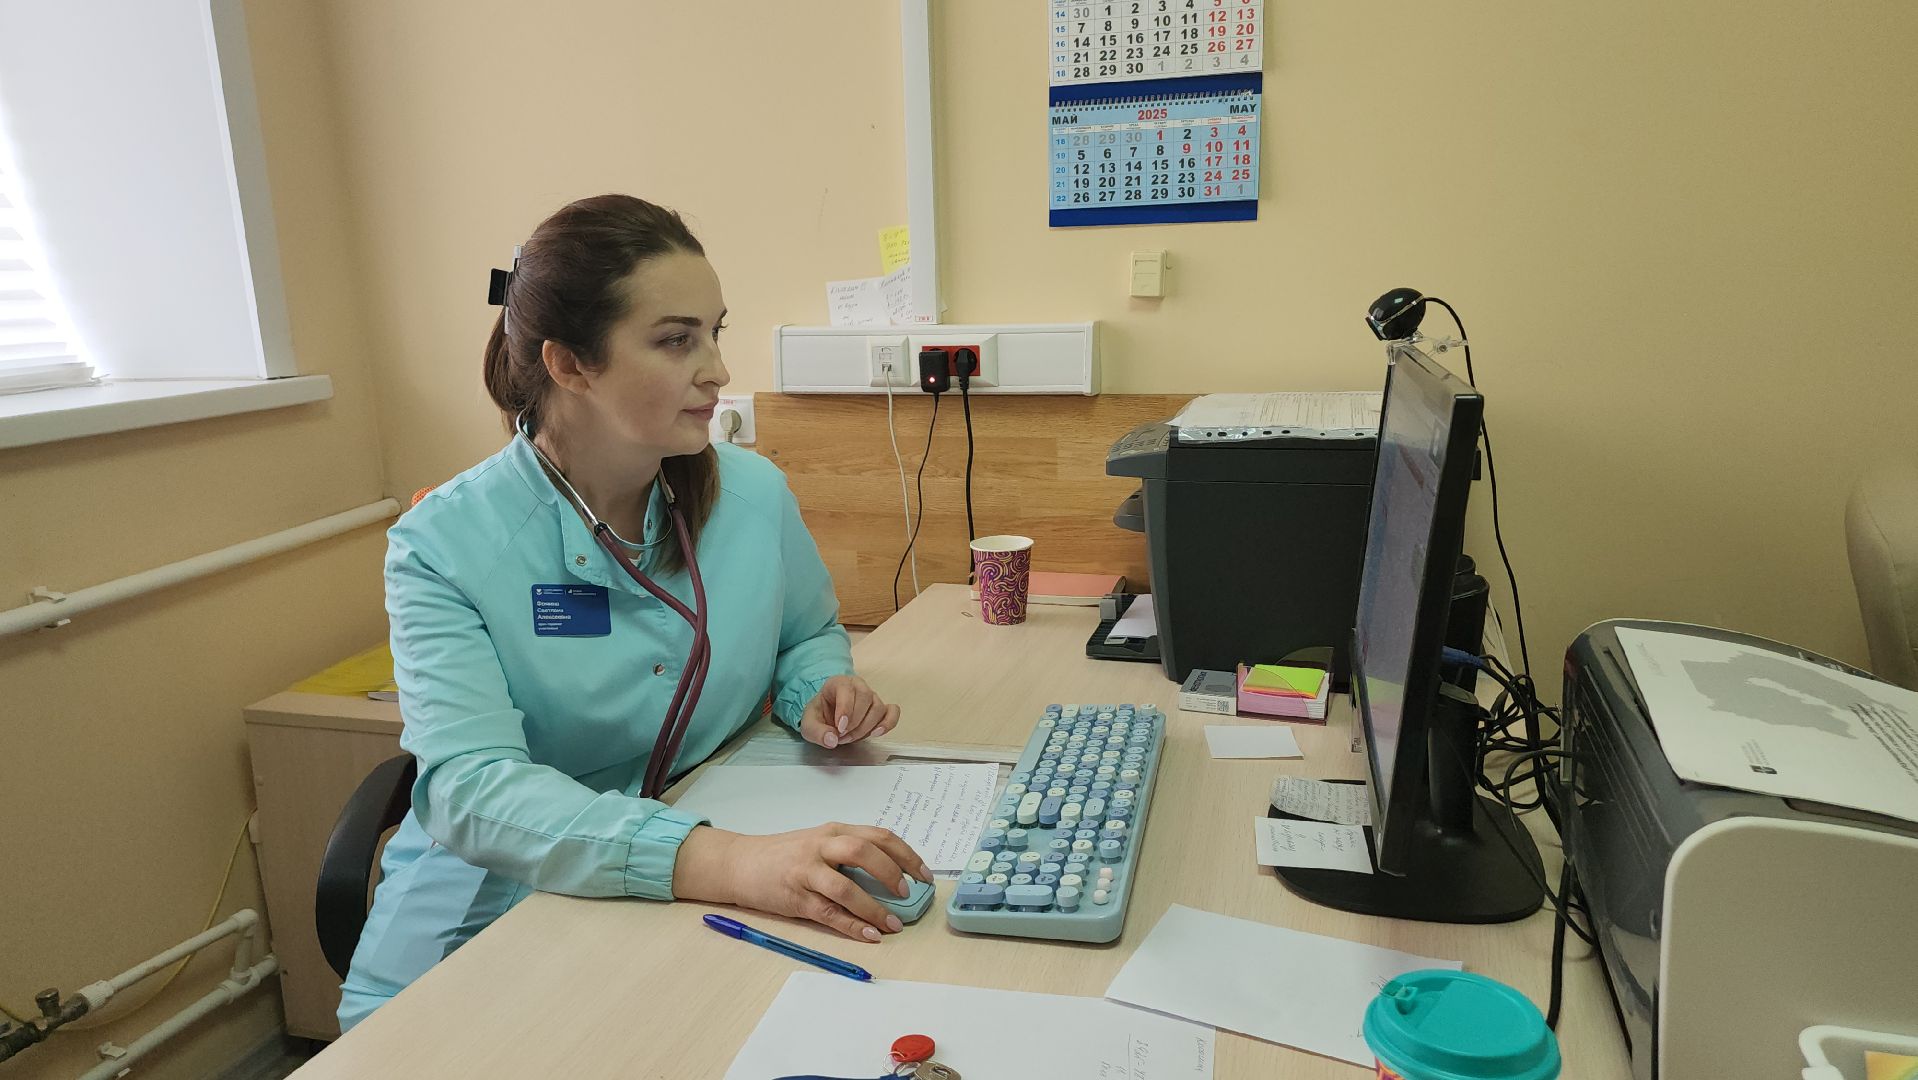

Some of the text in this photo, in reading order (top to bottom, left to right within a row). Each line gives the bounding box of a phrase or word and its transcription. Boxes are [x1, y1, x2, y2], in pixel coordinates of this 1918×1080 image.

[1073, 8, 1090, 18] 30
[1105, 6, 1112, 16] 1
[1132, 3, 1139, 14] 2
[1158, 1, 1167, 11] 3
[1186, 0, 1194, 9] 4
[1078, 23, 1086, 33] 7
[1104, 21, 1112, 31] 8
[1131, 19, 1139, 28] 9
[1154, 16, 1171, 27] 10
[1181, 13, 1198, 24] 11
[1208, 11, 1226, 22] 12
[1237, 9, 1254, 20] 13
[1073, 37, 1090, 48] 14
[1100, 35, 1116, 46] 15
[1127, 33, 1144, 44] 16
[1154, 31, 1170, 42] 17
[1181, 28, 1198, 39] 18
[1208, 26, 1226, 37] 19
[1236, 23, 1254, 35] 20
[1073, 52, 1089, 63] 21
[1100, 50, 1116, 61] 22
[1126, 48, 1143, 59] 23
[1153, 46, 1170, 57] 24
[1181, 44, 1198, 55] 25
[1208, 41, 1226, 52] 26
[1236, 39, 1254, 50] 27
[1074, 67, 1090, 78] 28
[1100, 65, 1116, 75] 29
[1126, 63, 1143, 74] 30
[1158, 61, 1164, 71] 1
[1185, 59, 1192, 69] 2
[1212, 57, 1220, 67] 3
[1240, 54, 1248, 64] 4
[1052, 115, 1078, 124] МАЙ
[1138, 109, 1168, 120] 2025
[1230, 104, 1257, 114] MAY
[1073, 135, 1090, 146] 28
[1099, 134, 1115, 144] 29
[1126, 132, 1142, 143] 30
[1157, 130, 1163, 140] 1
[1183, 129, 1191, 139] 2
[1210, 127, 1218, 137] 3
[1238, 125, 1246, 135] 4
[1078, 150, 1085, 160] 5
[1104, 148, 1111, 158] 6
[1130, 147, 1137, 157] 7
[1157, 145, 1164, 155] 8
[1183, 144, 1191, 153] 9
[1206, 141, 1223, 152] 10
[1233, 139, 1249, 150] 11
[1073, 164, 1090, 175] 12
[1099, 162, 1115, 173] 13
[1125, 161, 1142, 172] 14
[1152, 159, 1169, 170] 15
[1179, 157, 1195, 168] 16
[1205, 156, 1222, 166] 17
[1233, 153, 1250, 164] 18
[1074, 178, 1090, 188] 19
[1099, 176, 1115, 187] 20
[1125, 175, 1141, 186] 21
[1151, 174, 1168, 185] 22
[1178, 172, 1195, 183] 23
[1204, 170, 1222, 181] 24
[1232, 169, 1250, 180] 25
[1074, 192, 1090, 202] 26
[1099, 191, 1115, 201] 27
[1125, 190, 1141, 200] 28
[1151, 188, 1168, 199] 29
[1178, 186, 1194, 197] 30
[1204, 185, 1220, 196] 31
[1239, 184, 1243, 194] 1
